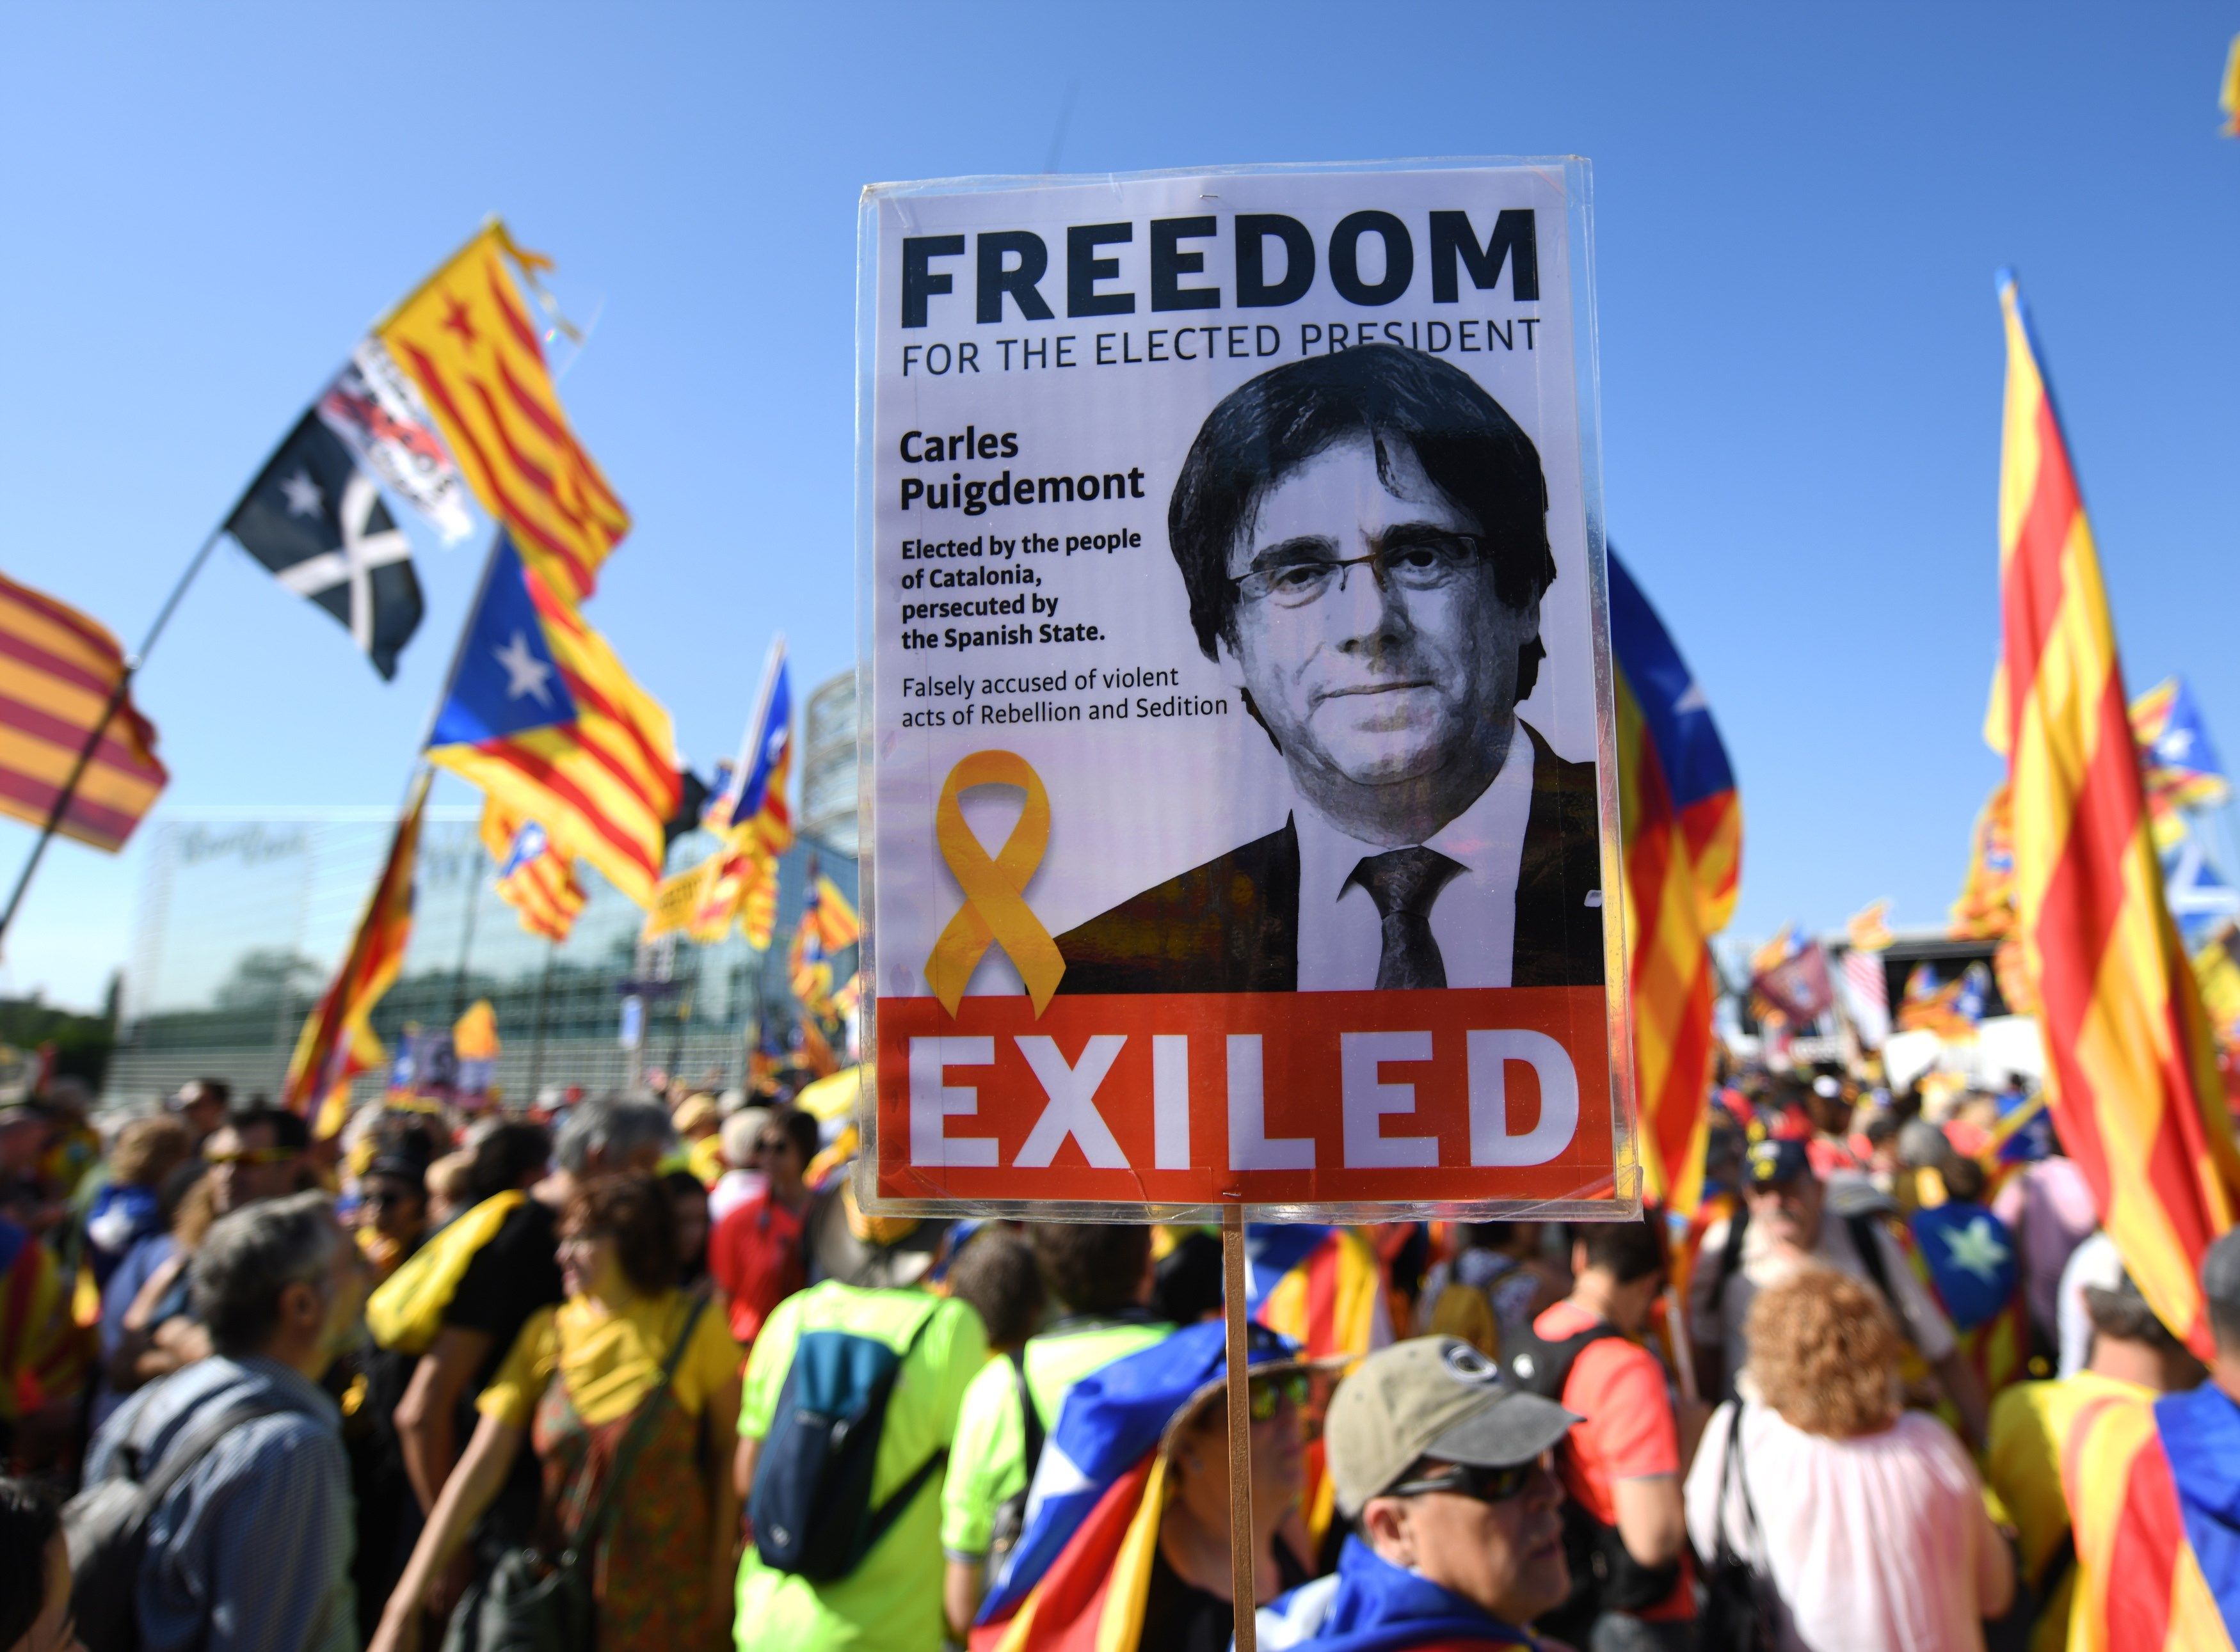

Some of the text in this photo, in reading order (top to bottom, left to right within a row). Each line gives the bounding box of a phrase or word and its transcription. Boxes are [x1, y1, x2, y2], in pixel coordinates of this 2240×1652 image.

[902, 209, 1540, 330] FREEDOM
[904, 318, 1540, 376] FOR THE ELECTED PRESIDENT
[900, 425, 1018, 463] Carles
[902, 468, 1144, 516] Puigdemont
[902, 528, 1140, 559] Elected by the people
[902, 564, 1041, 589] of Catalonia,
[903, 593, 1058, 624] persecuted by
[902, 624, 1105, 651] the Spanish State.
[904, 667, 1178, 699] Falsely accused of violent
[902, 695, 1227, 727] acts of Rebellion and Sedition
[909, 1029, 1580, 1171] EXILED
